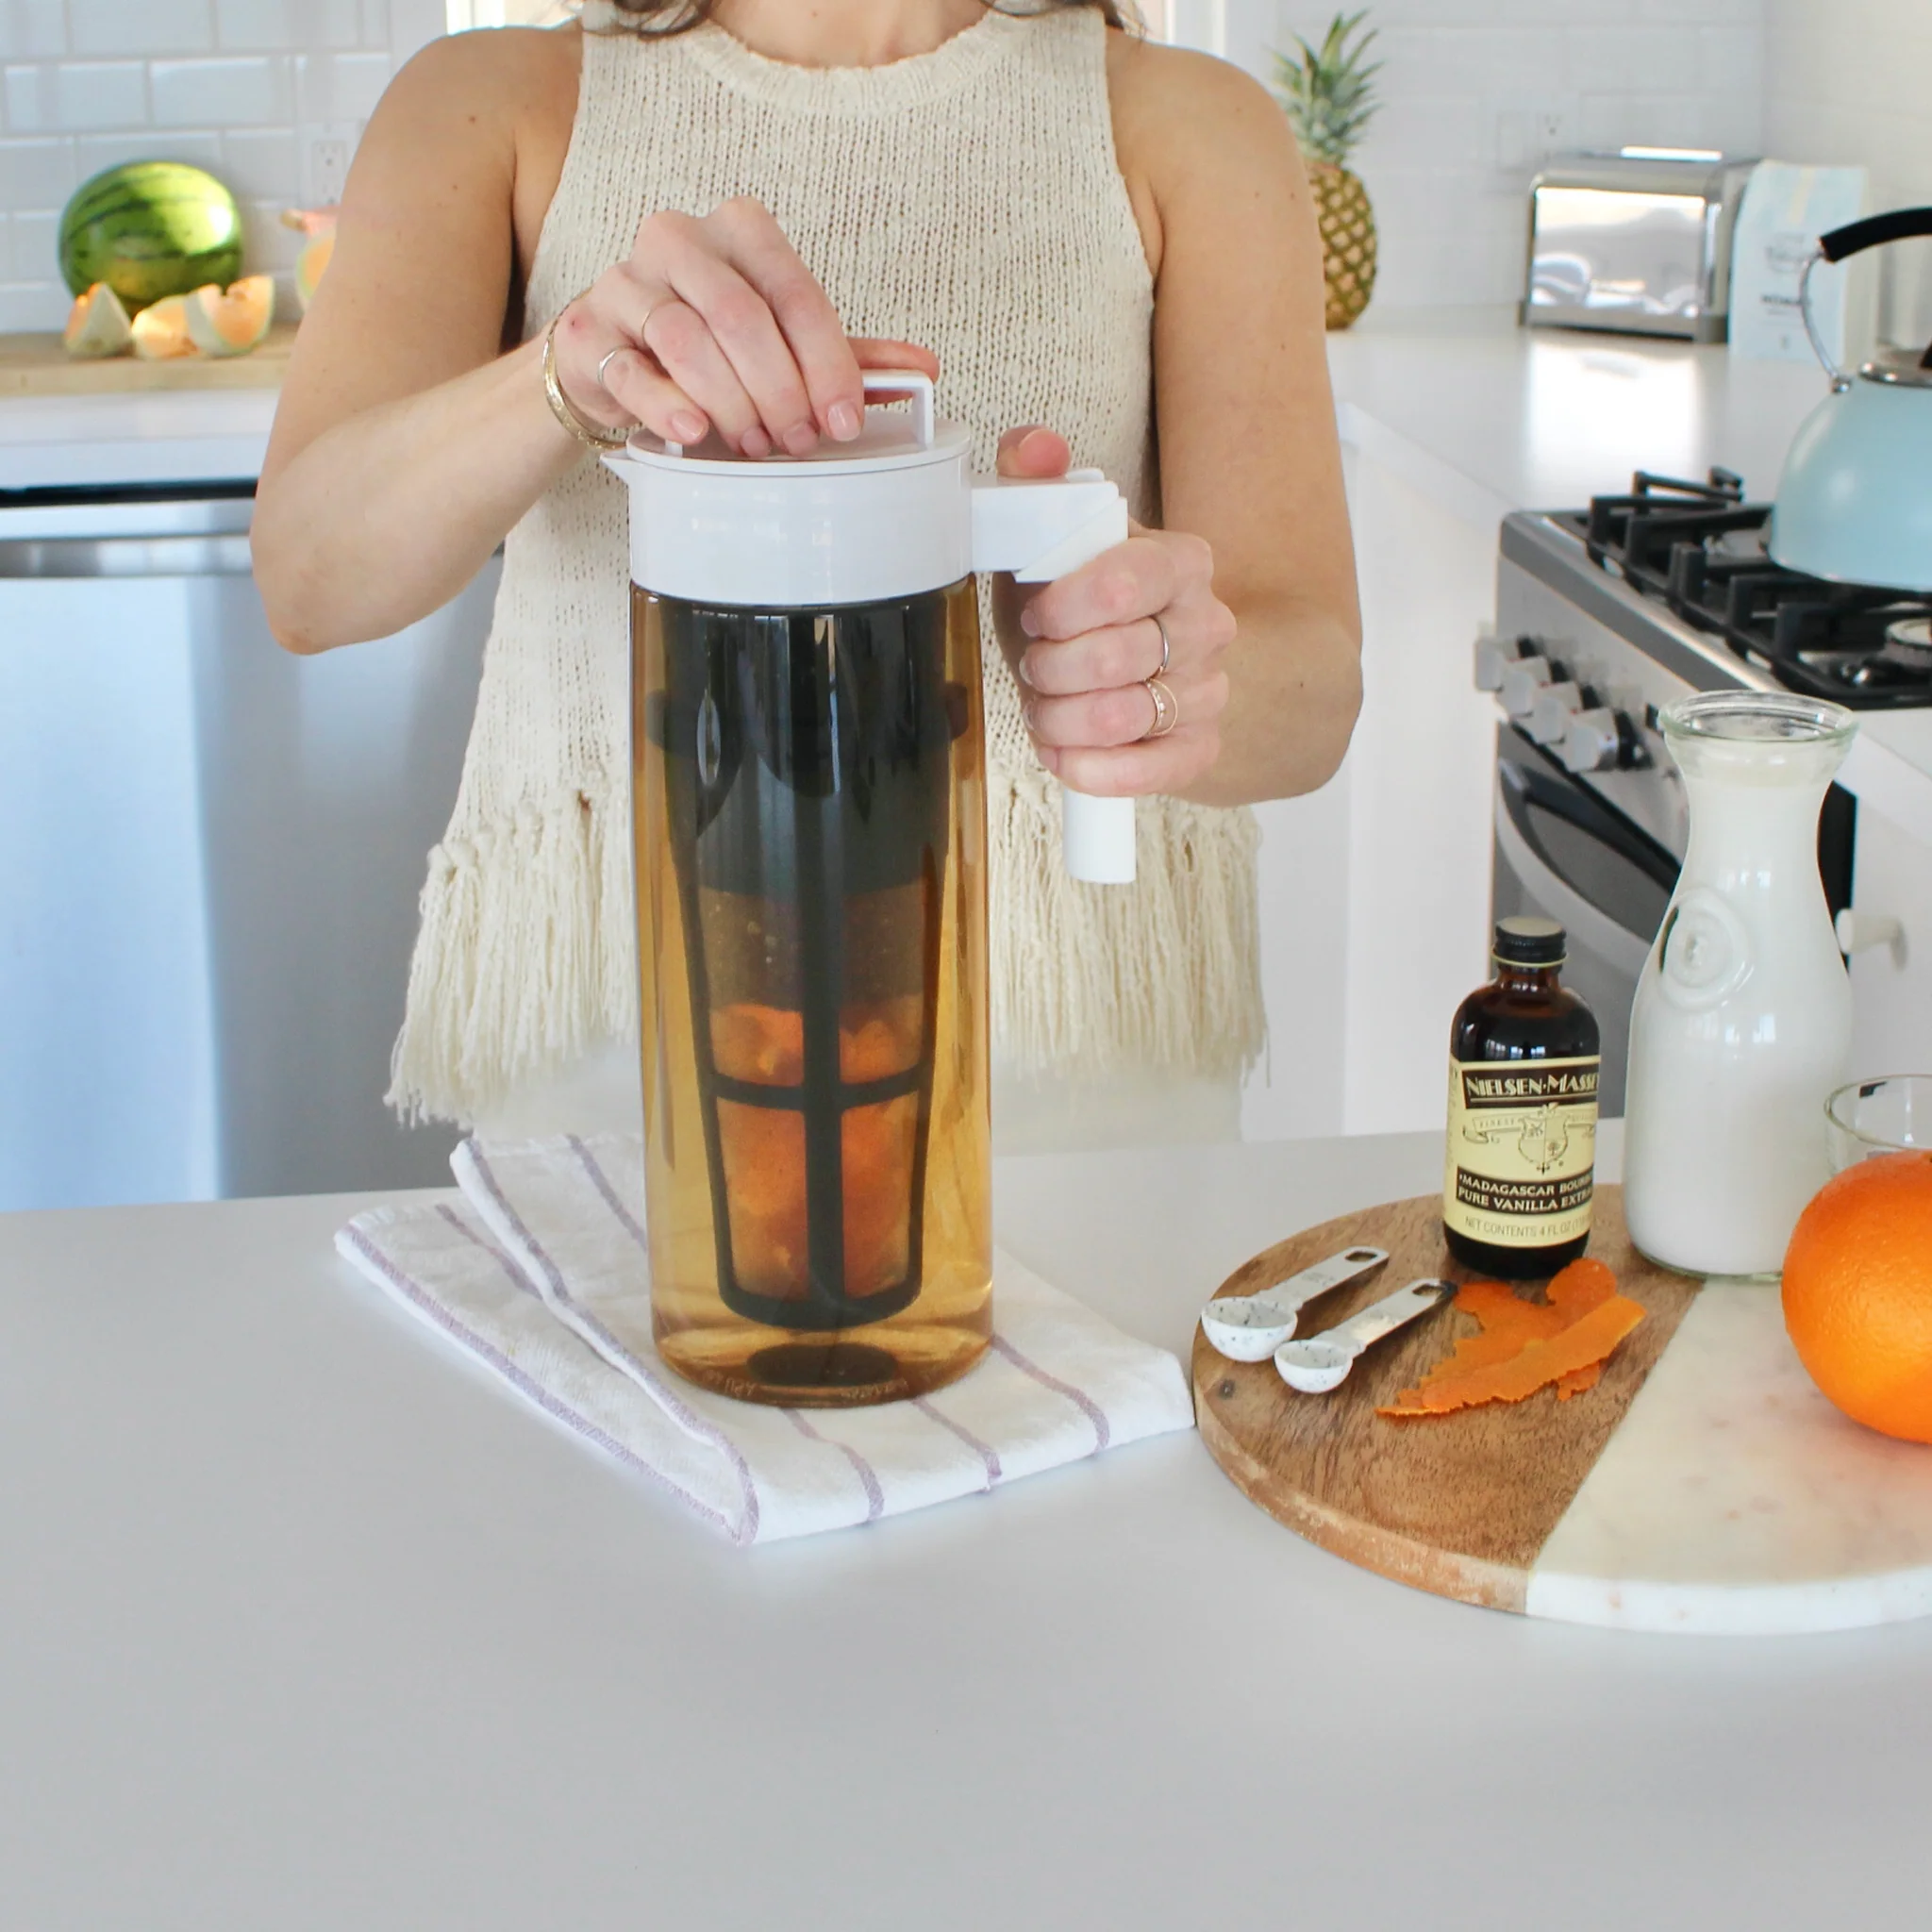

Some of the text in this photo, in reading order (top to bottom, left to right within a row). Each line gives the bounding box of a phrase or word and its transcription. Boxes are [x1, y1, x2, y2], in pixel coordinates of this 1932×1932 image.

[1462, 1174, 1555, 1196] MADAGASCAR
[1458, 1186, 1489, 1207] PURE
[1494, 1198, 1558, 1210] VANILLA
[1464, 1216, 1481, 1230] NET
[1483, 1222, 1537, 1237] CONTENTS
[1541, 1225, 1545, 1236] 4
